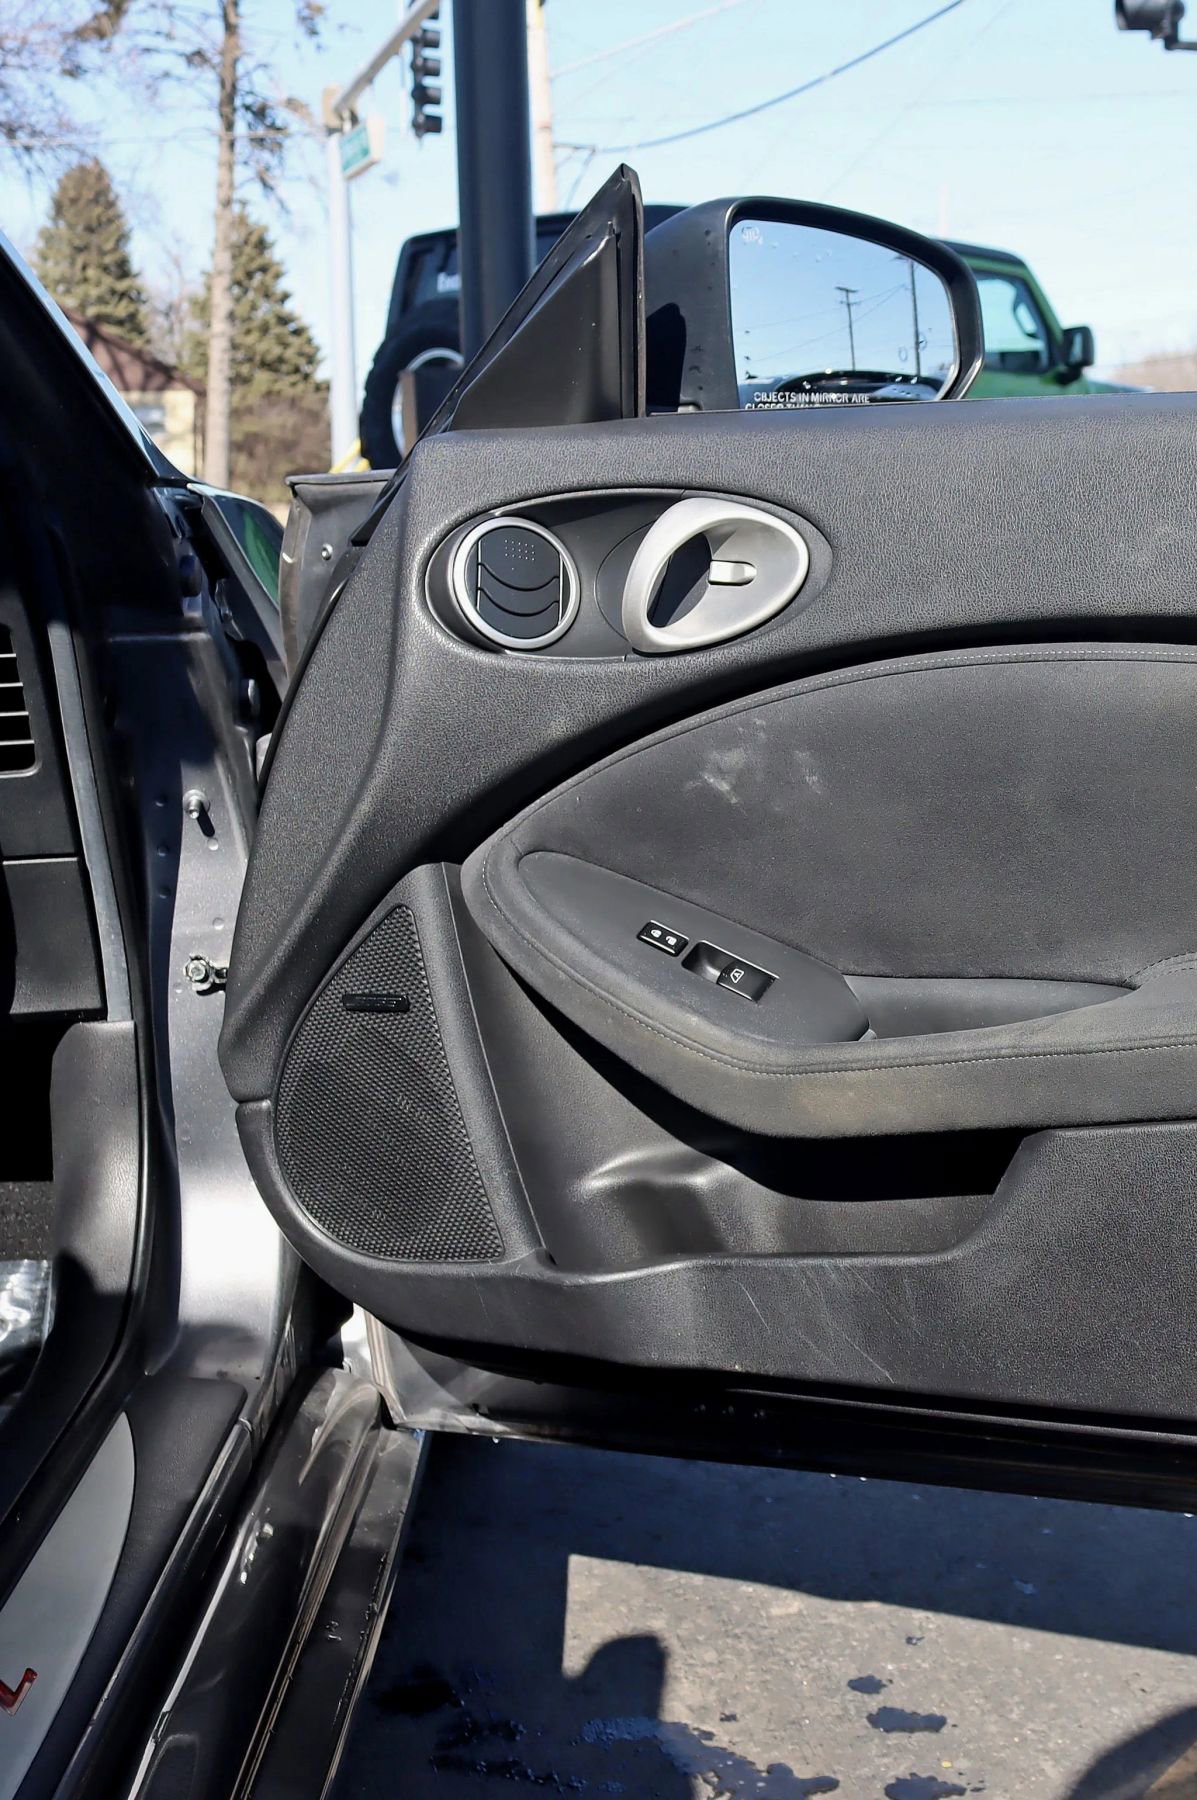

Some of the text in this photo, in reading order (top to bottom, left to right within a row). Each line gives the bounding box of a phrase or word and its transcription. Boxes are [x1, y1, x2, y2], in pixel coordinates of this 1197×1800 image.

[754, 391, 870, 404] OBJECTS IN MIRROR ARE
